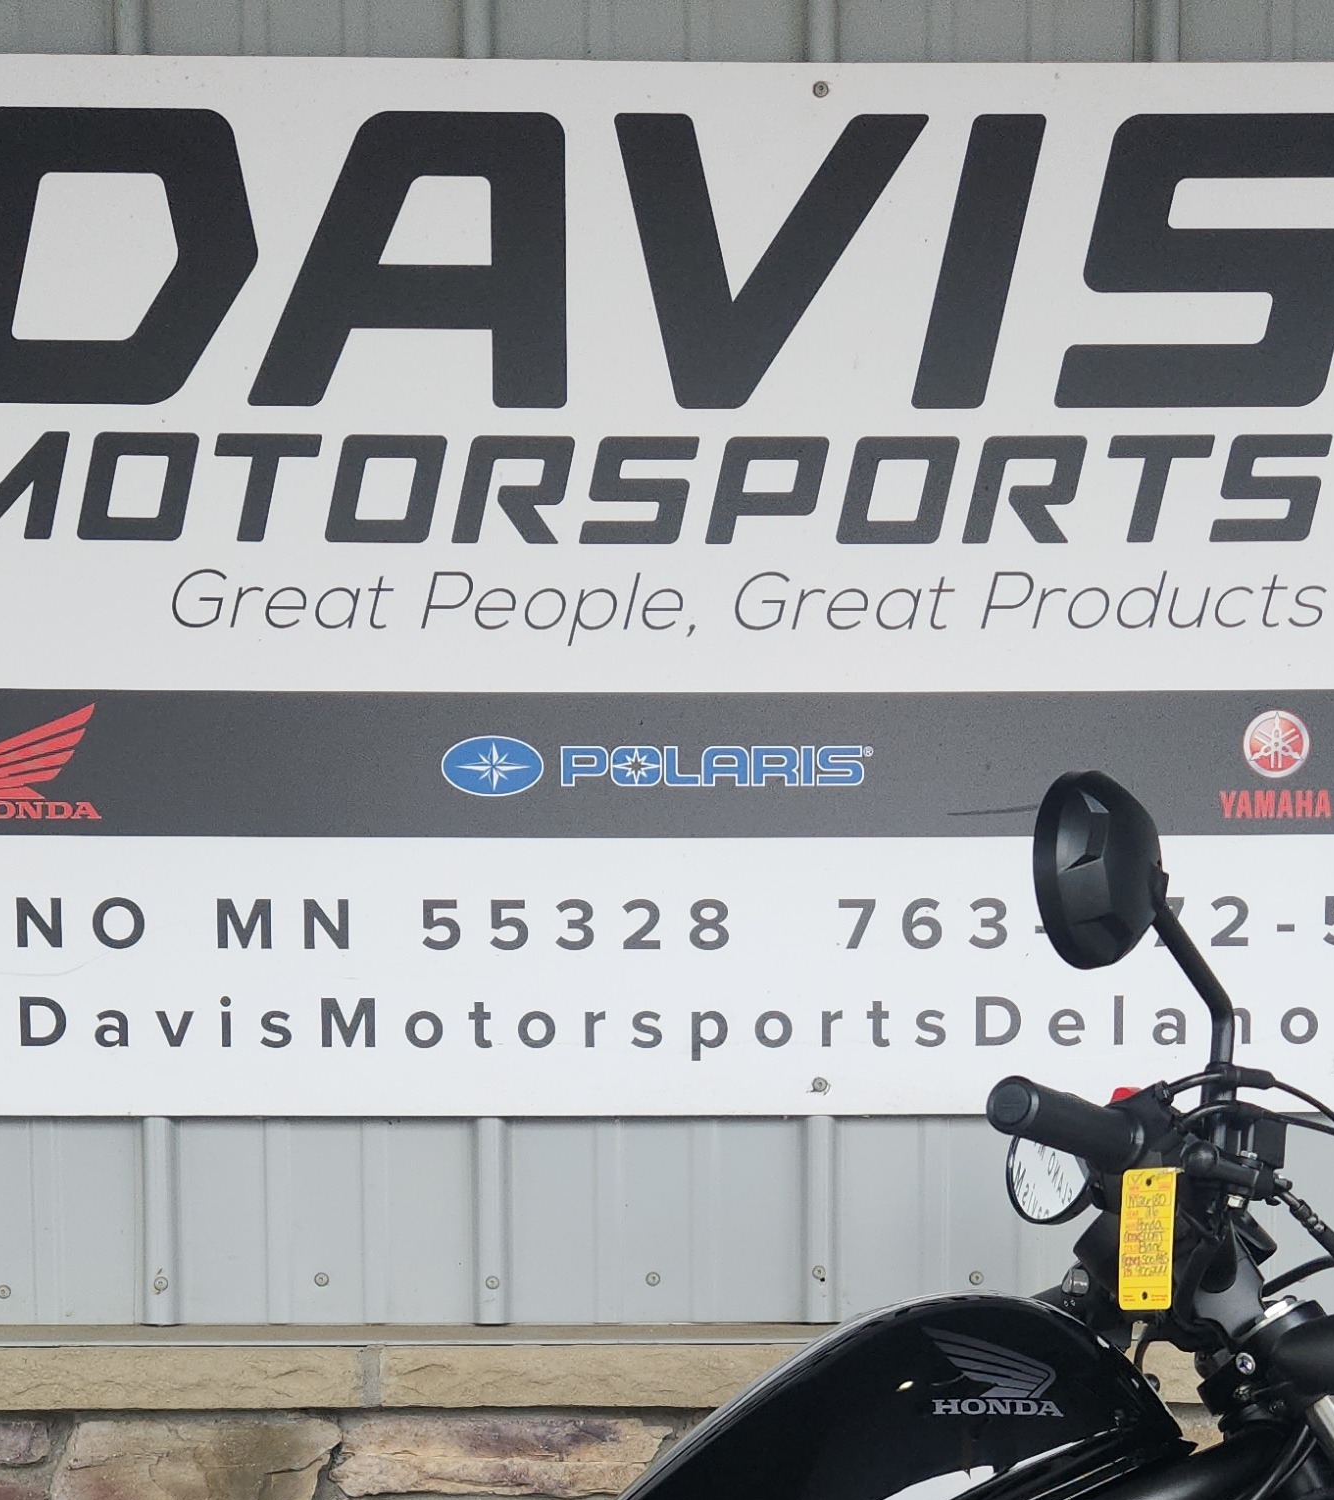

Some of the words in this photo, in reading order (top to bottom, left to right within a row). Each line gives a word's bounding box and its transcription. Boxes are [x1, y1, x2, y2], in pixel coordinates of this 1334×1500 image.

[171, 568, 394, 631] Great
[421, 571, 696, 647] People,
[734, 571, 956, 631] Great
[981, 570, 1328, 630] Products
[1220, 790, 1332, 819] YAMAHA
[217, 899, 350, 950] MN
[423, 899, 731, 952] 55328
[933, 1398, 1065, 1418] HONDA
